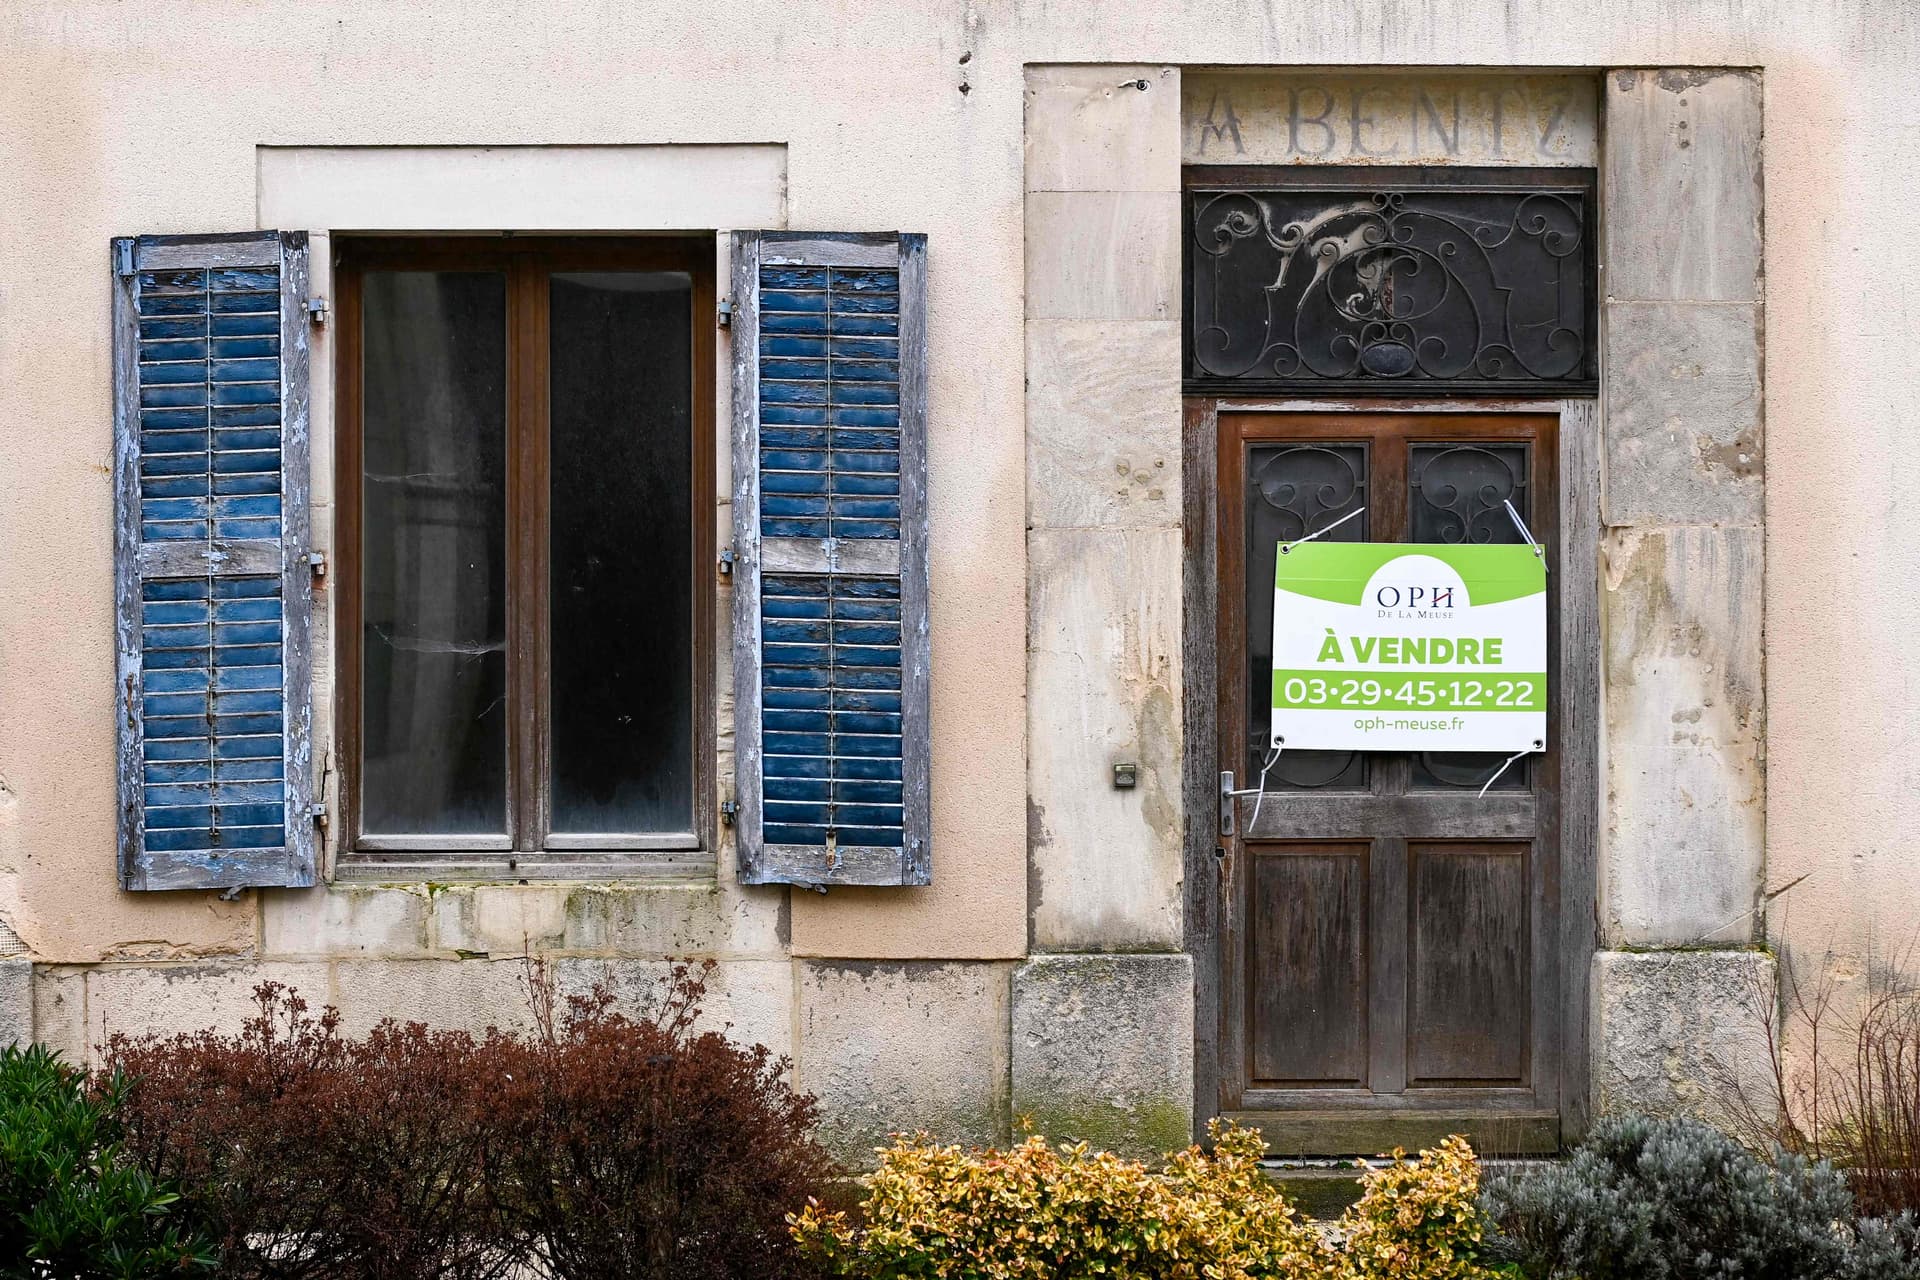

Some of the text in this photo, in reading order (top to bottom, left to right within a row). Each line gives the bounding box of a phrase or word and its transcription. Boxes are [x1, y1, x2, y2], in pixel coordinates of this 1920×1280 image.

[1377, 586, 1455, 608] OPH
[1316, 628, 1503, 665] À VENDRE
[1353, 716, 1465, 733] oph-meuse.fr
